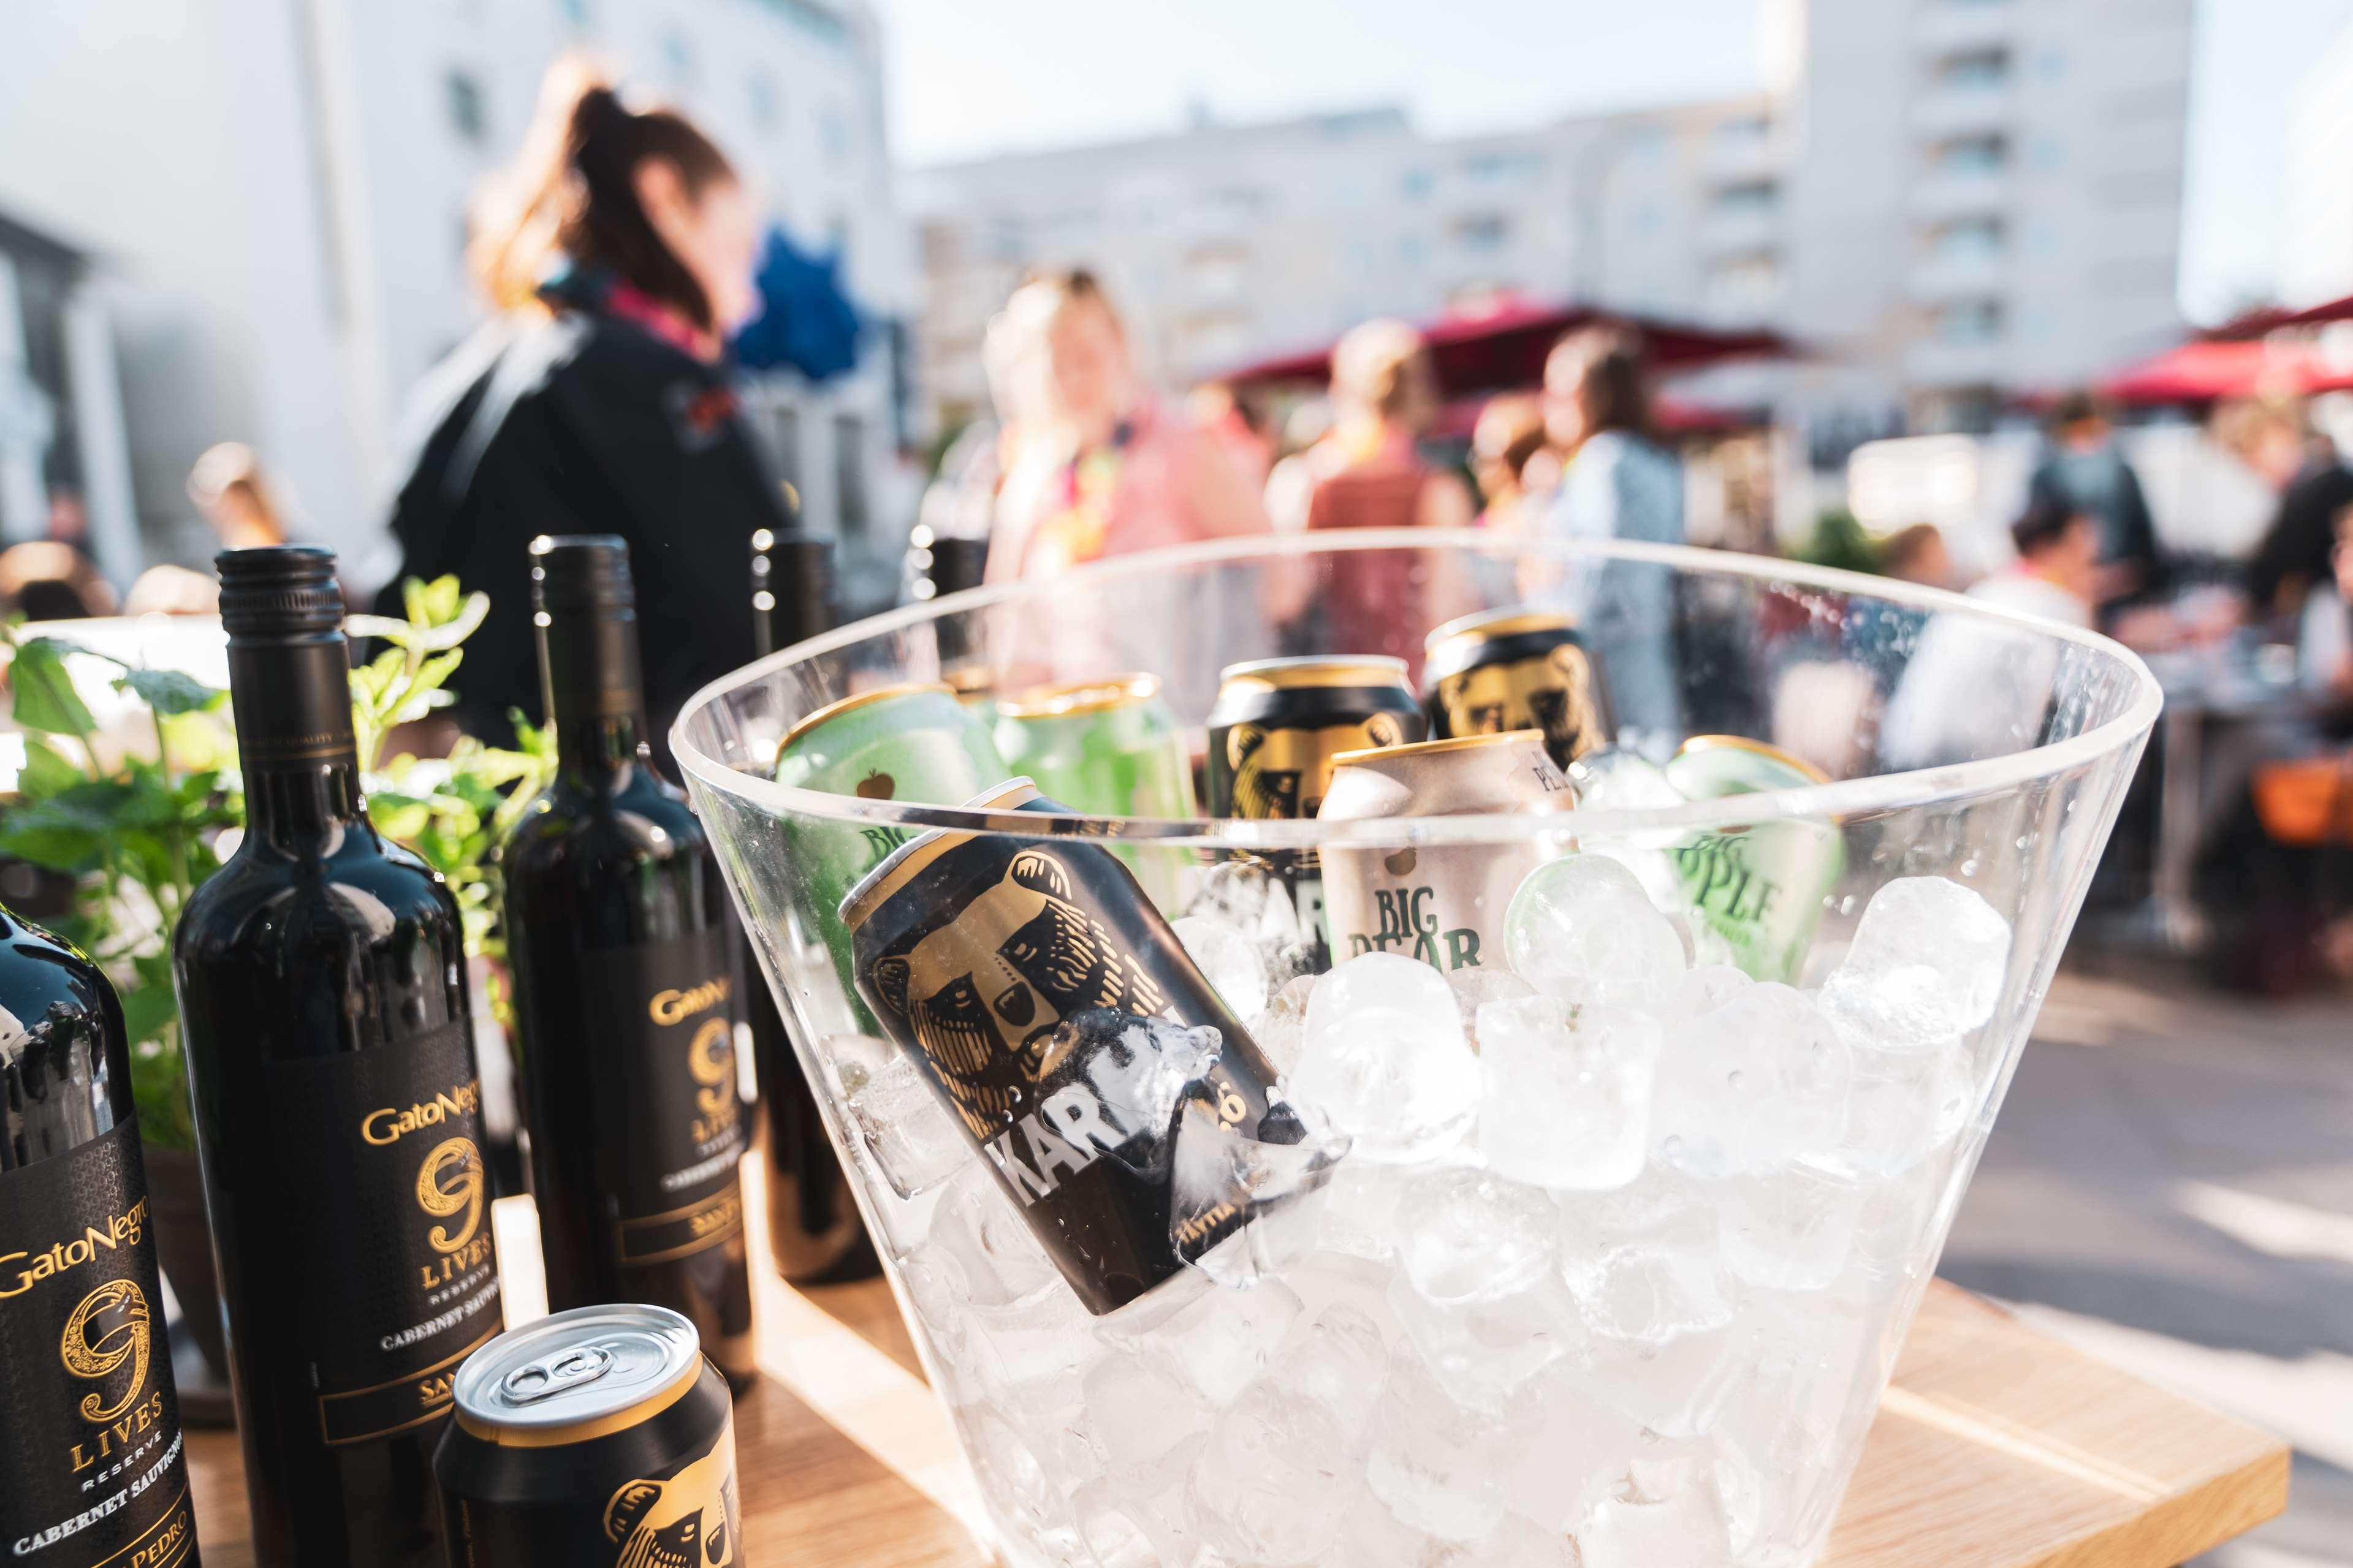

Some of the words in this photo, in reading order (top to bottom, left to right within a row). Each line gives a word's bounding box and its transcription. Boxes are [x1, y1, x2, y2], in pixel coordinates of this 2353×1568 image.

[1375, 886, 1438, 939] BIG
[362, 1081, 479, 1145] GatoNeg
[983, 1005, 1207, 1208] KARH
[0, 1195, 150, 1299] GatoNegro
[61, 1278, 150, 1423] 9
[69, 1391, 163, 1474] LIVES
[80, 1430, 163, 1493] RESERVE
[12, 1487, 127, 1556] CABERNET
[130, 1510, 188, 1568] PEDRO
